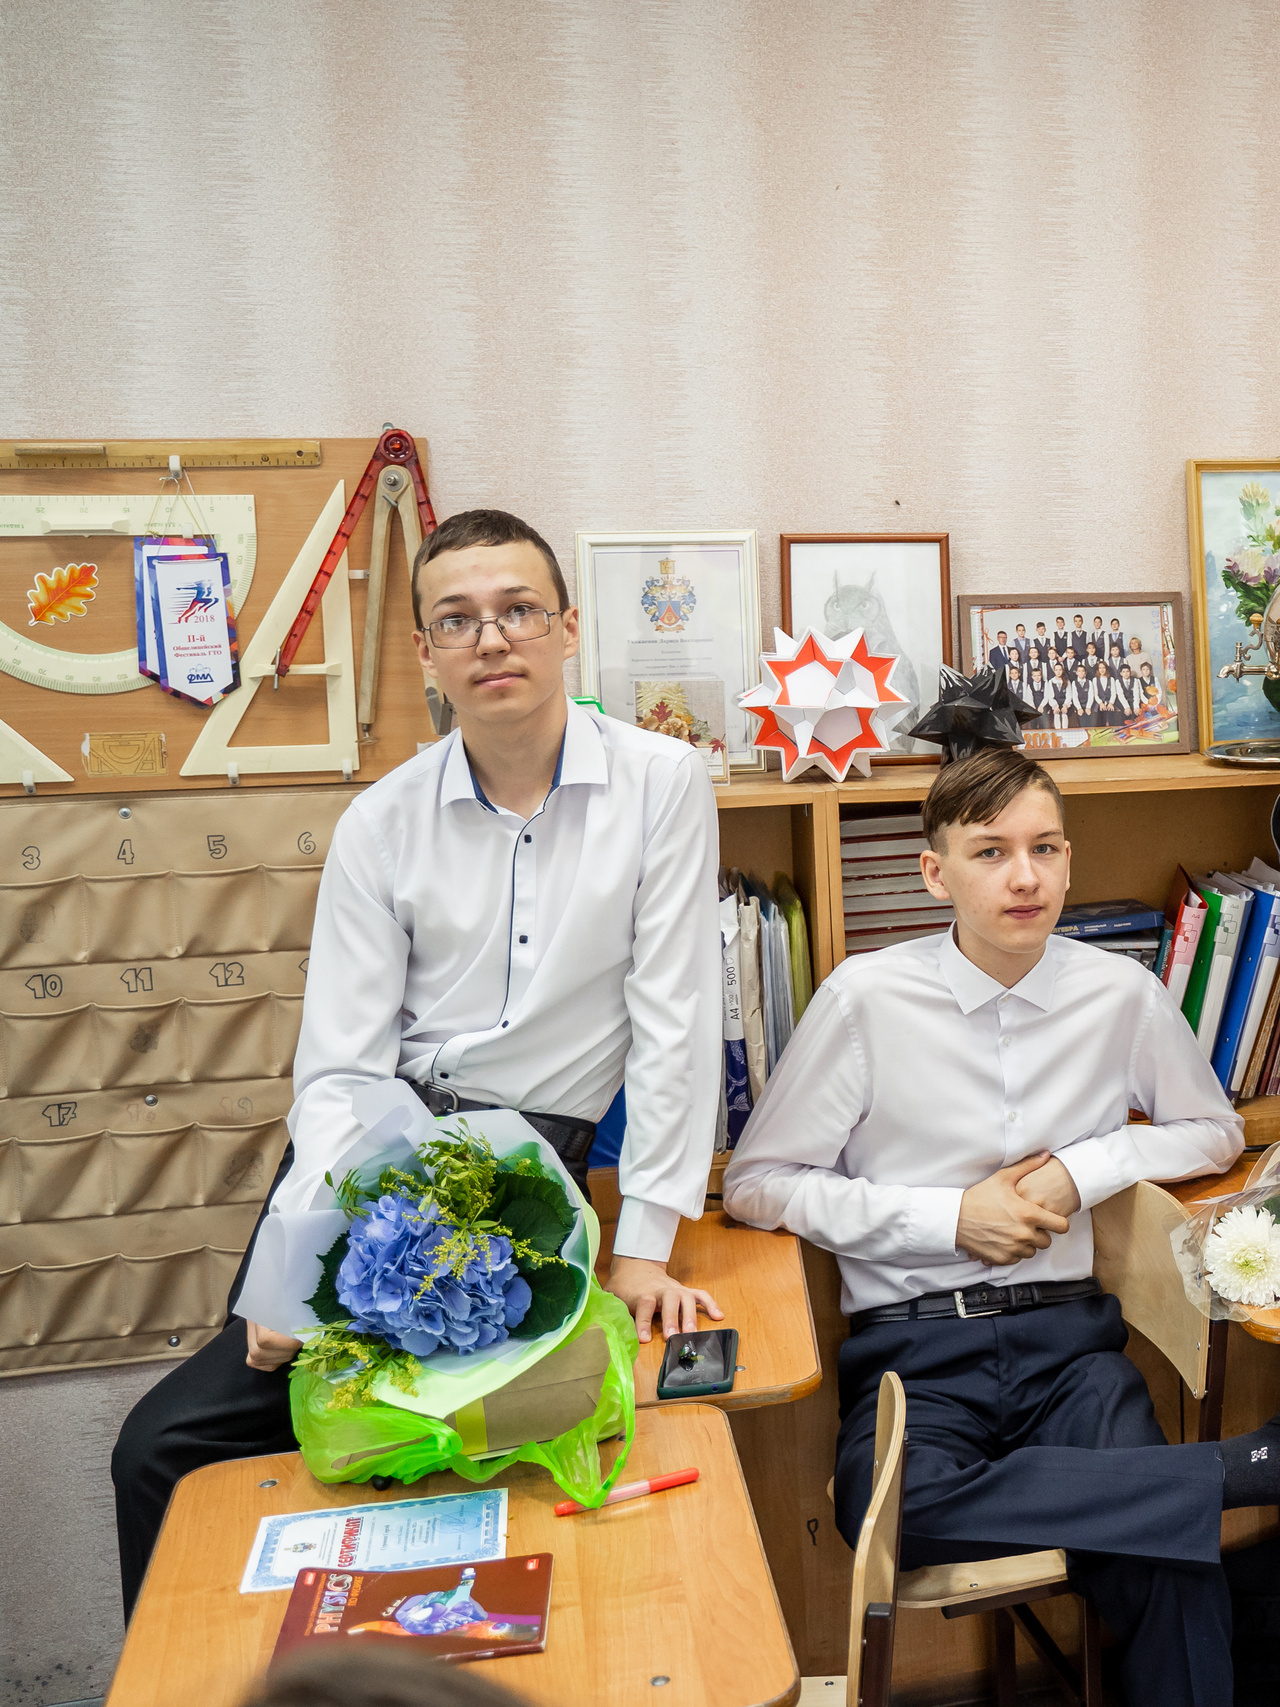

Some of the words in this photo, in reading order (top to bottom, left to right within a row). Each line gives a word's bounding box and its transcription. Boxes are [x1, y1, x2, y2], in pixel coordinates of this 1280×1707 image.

[194, 615, 215, 623] 2018
[117, 839, 135, 865] 4
[207, 834, 228, 859] 5
[297, 831, 317, 855] 6
[22, 845, 41, 870] 3
[1051, 925, 1079, 933] ЛГЕБРА
[25, 973, 63, 999] 10
[120, 967, 154, 993] 11
[209, 962, 245, 988] 12
[726, 966, 736, 986] 500
[730, 1008, 740, 1020] A4
[42, 1101, 77, 1128] 17
[337, 1516, 363, 1568] СЕРТИФИКАТ
[314, 1573, 353, 1633] PHYSICS
[348, 1598, 358, 1606] ПО
